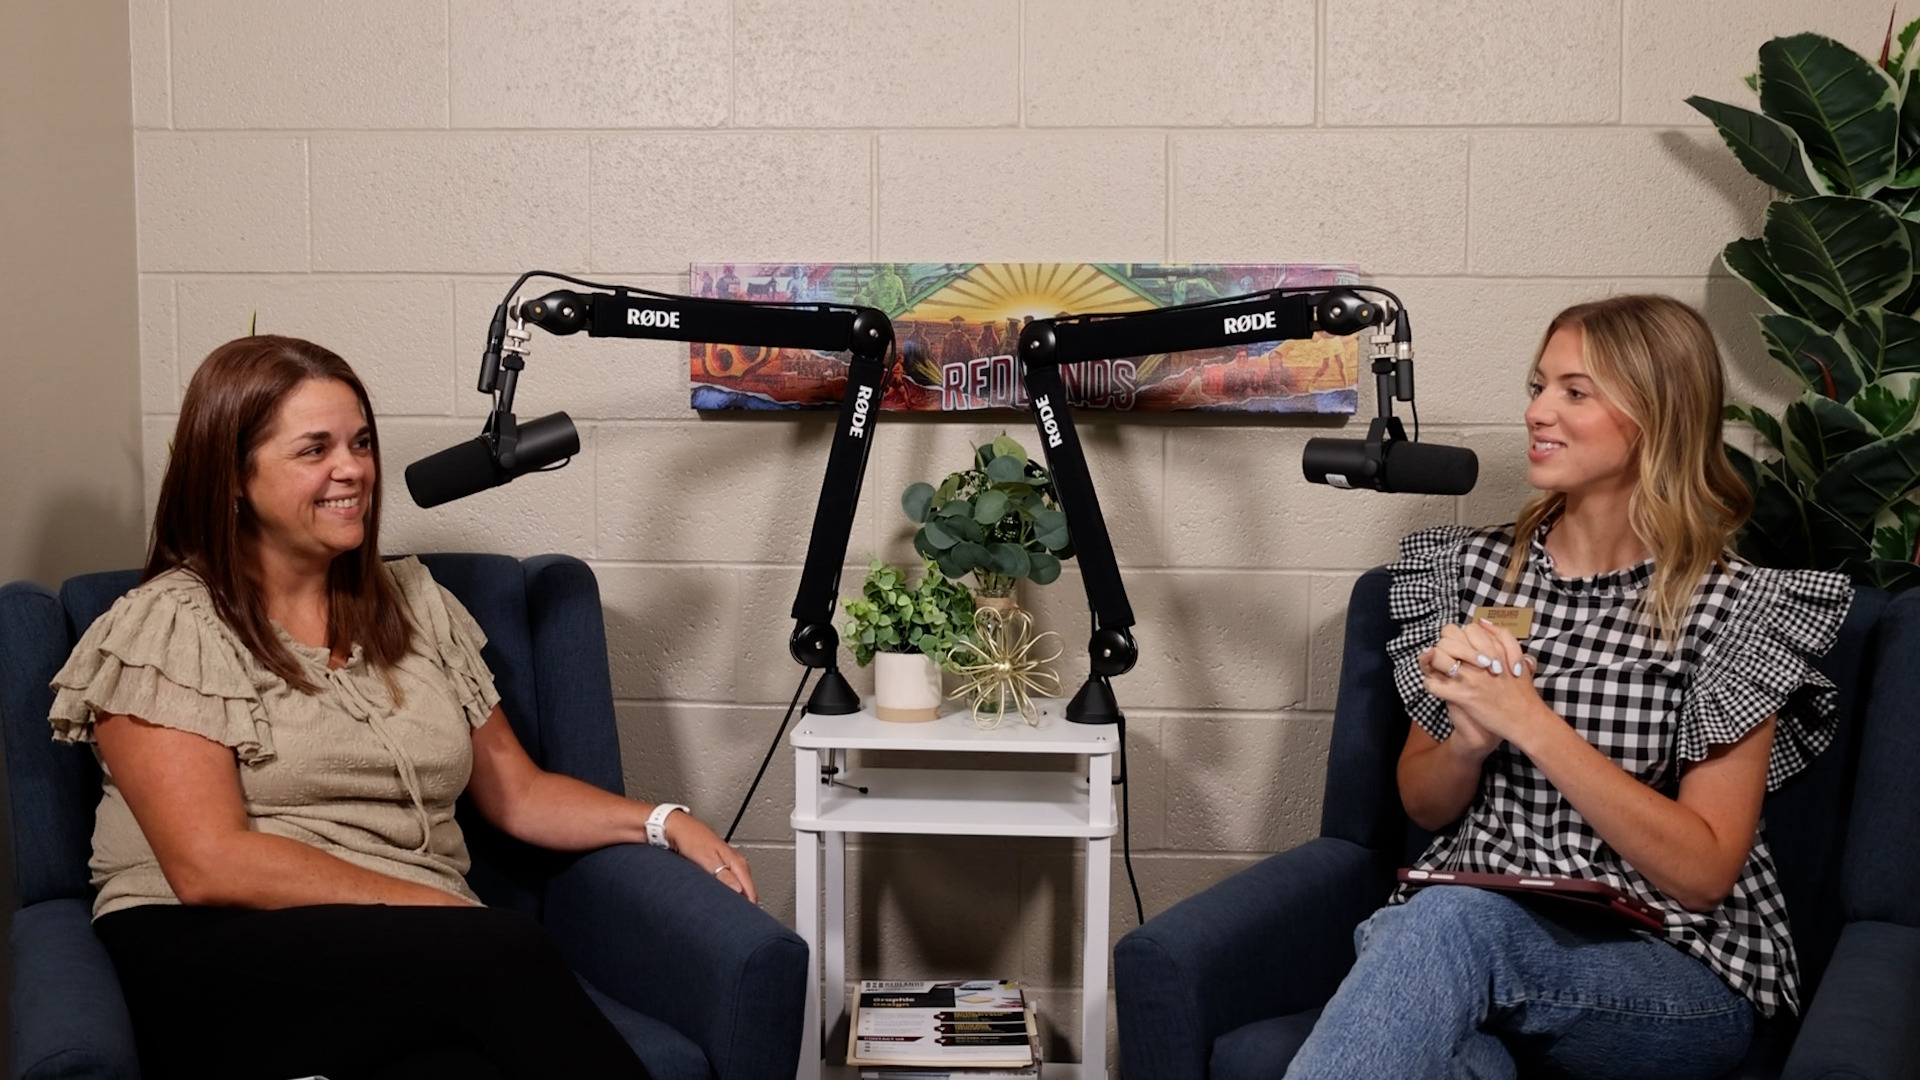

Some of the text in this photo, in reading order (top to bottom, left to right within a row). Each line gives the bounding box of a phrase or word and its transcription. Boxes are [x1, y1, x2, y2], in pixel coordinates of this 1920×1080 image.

[627, 308, 680, 329] RØDE
[1224, 310, 1277, 335] RØDE
[849, 385, 873, 438] RØDE
[1035, 394, 1063, 448] RØDE
